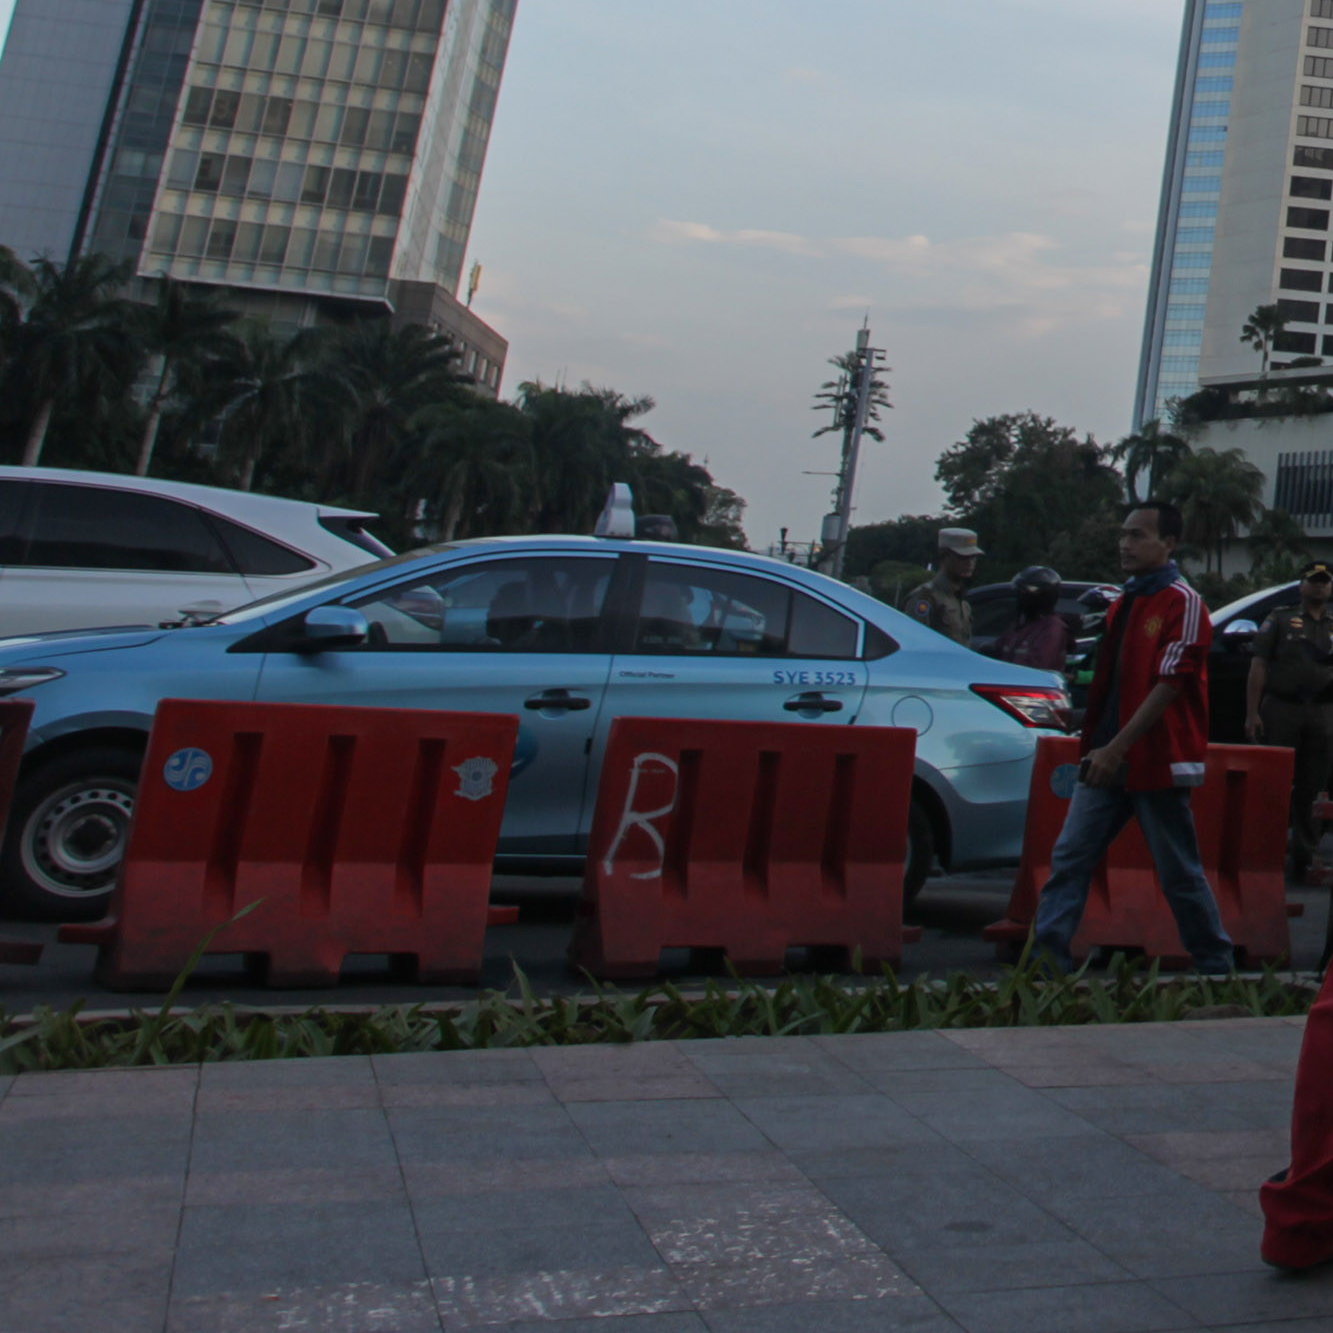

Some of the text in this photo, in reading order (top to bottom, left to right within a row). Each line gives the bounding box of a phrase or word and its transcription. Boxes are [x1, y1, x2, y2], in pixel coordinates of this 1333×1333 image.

[773, 670, 857, 686] SYE 3523
[602, 752, 679, 880] R
